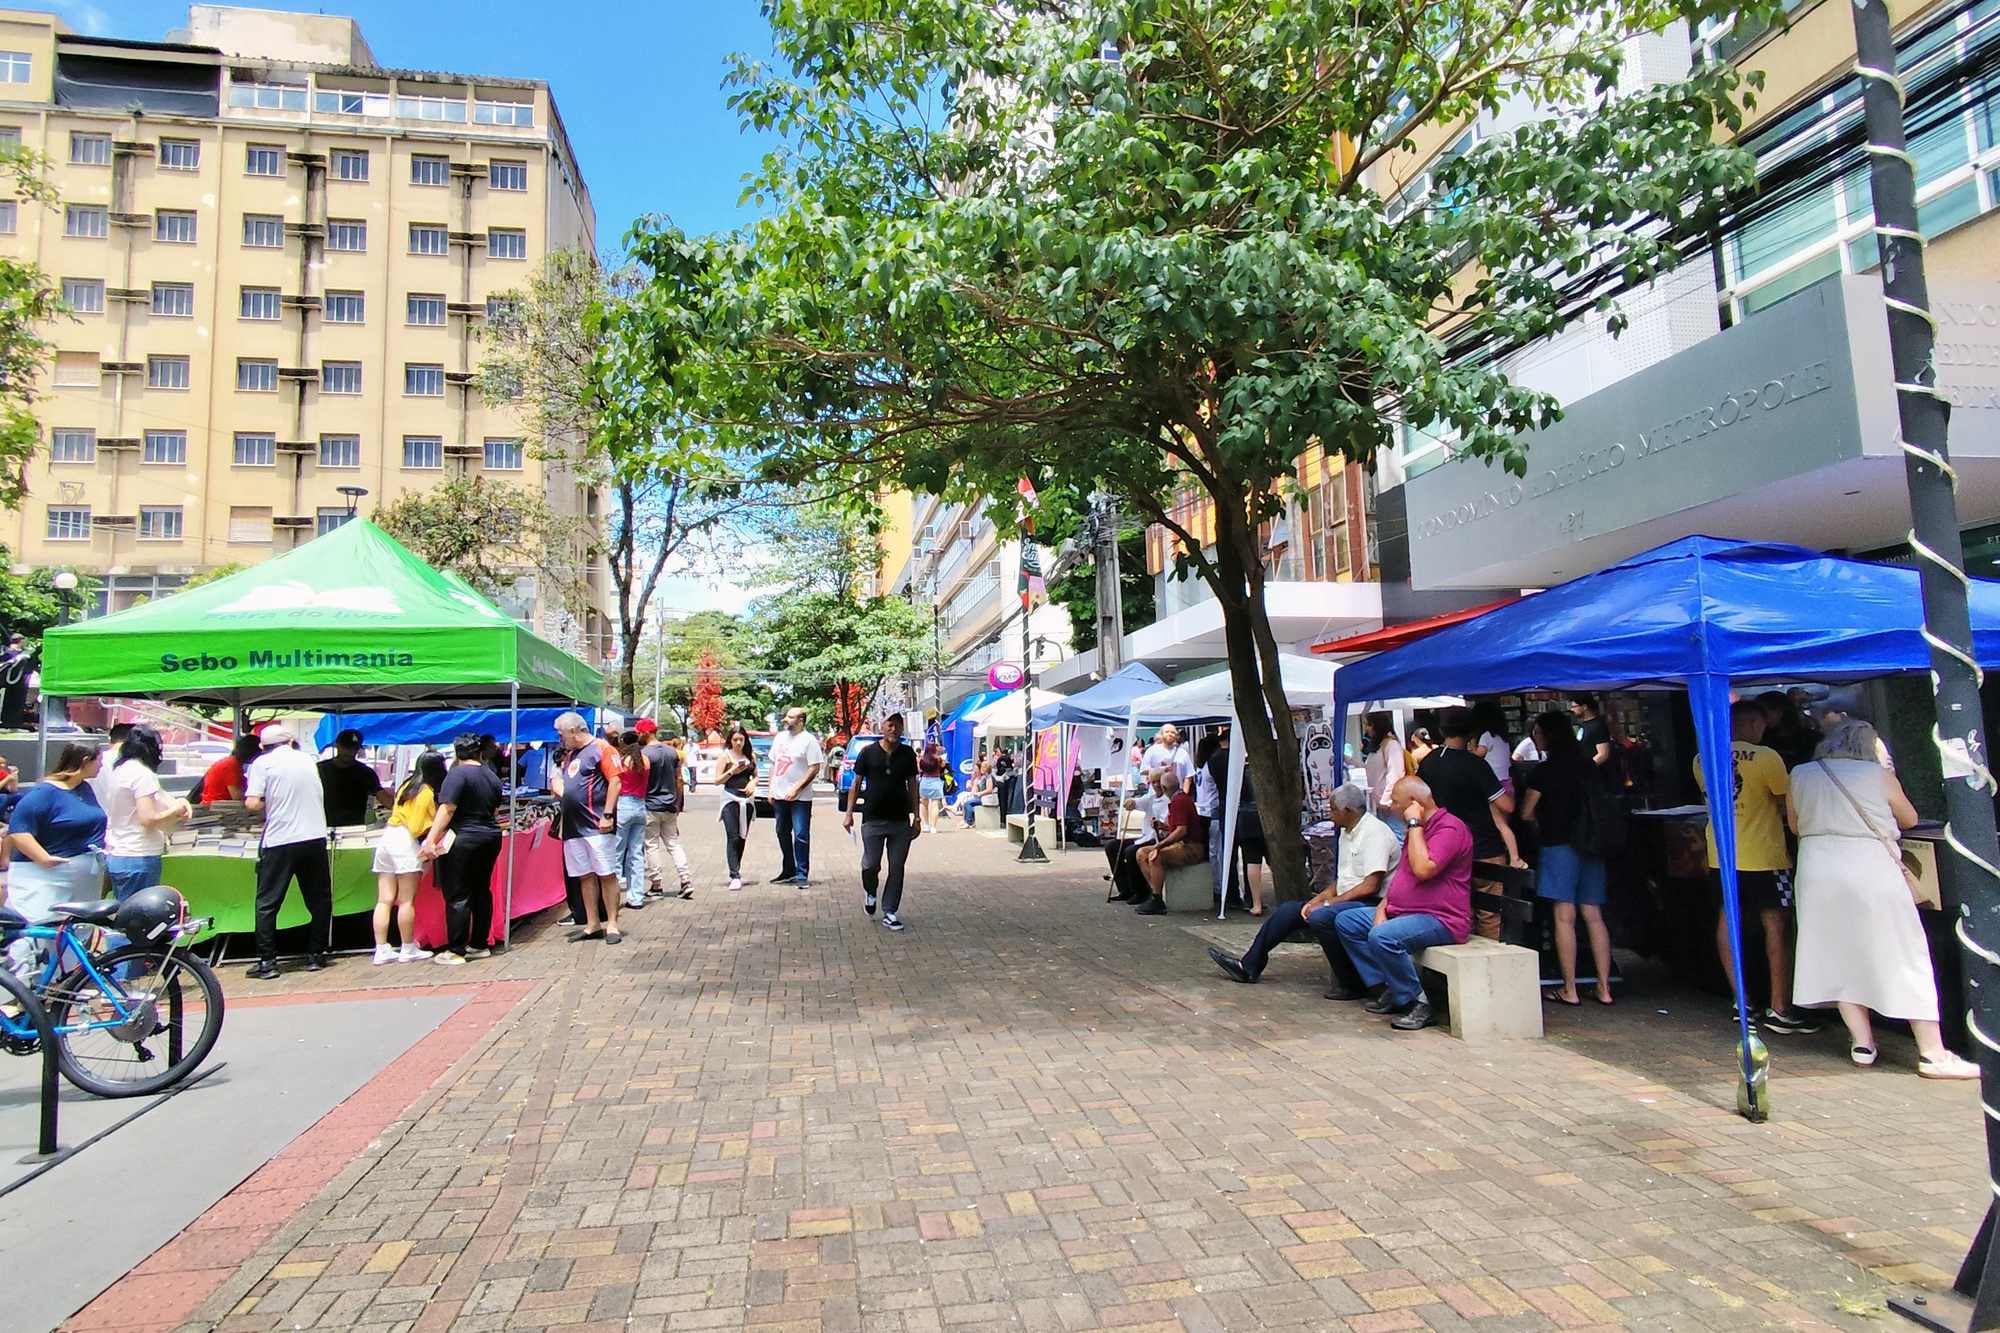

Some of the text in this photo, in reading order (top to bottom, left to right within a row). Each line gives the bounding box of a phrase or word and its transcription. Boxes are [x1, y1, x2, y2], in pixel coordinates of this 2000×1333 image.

[1635, 359, 1833, 460] METRÓPOLE
[159, 648, 414, 673] Sebo Multimania
